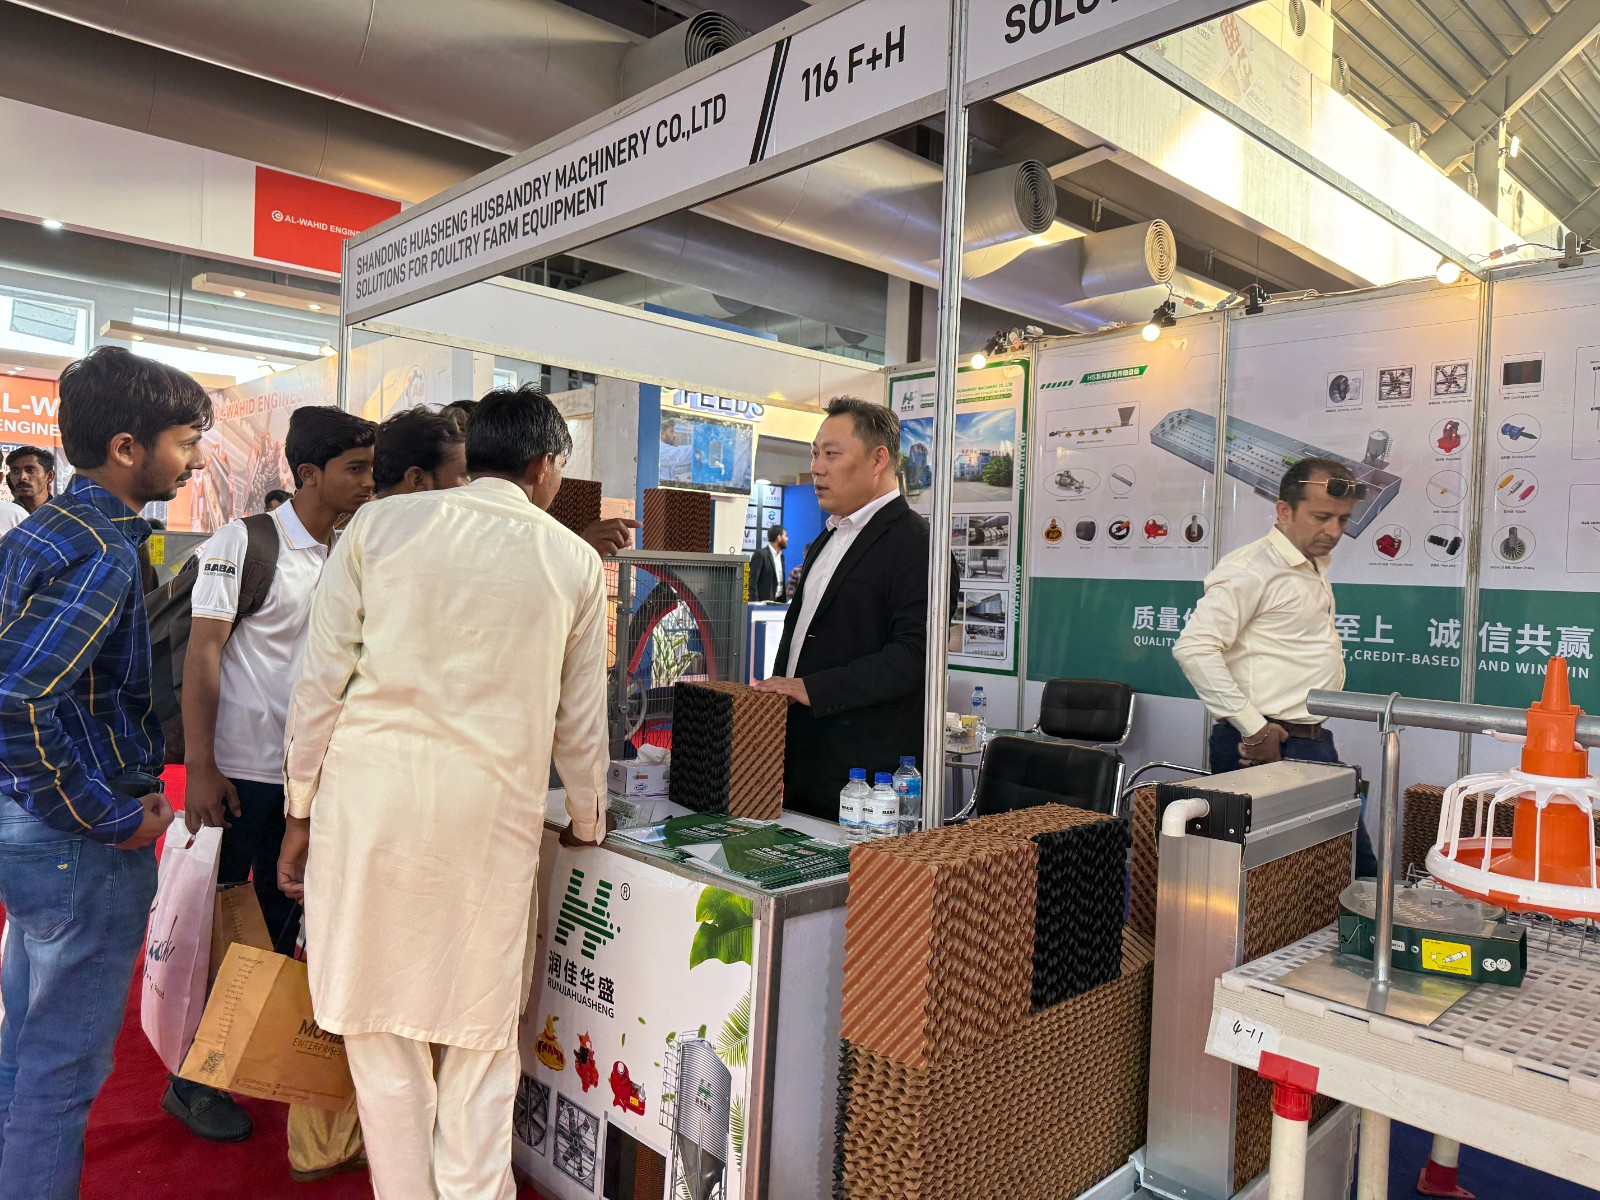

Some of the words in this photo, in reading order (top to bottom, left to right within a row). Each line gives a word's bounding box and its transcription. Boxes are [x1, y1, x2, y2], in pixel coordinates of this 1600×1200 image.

[801, 56, 838, 102] 116
[848, 25, 906, 83] F+H
[357, 237, 407, 276] SHANDONG
[409, 210, 468, 250] HUASHENG
[471, 171, 551, 229] HUSBANDRY
[555, 126, 651, 192] MACHINERY
[656, 93, 727, 148] CO.,LTD
[285, 214, 328, 231] AL-WAHID
[356, 263, 406, 299] SOLUTIONS
[408, 255, 428, 281] FOR
[431, 232, 481, 271] POULTRY
[483, 217, 519, 252] FARM
[523, 180, 608, 237] EQUIPMENT
[0, 392, 59, 417] L-W
[214, 398, 255, 422] AL-WAHID
[204, 563, 236, 576] BABA
[1132, 605, 1197, 632] 质量
[1478, 660, 1510, 672] AND
[1565, 666, 1589, 679] IN
[547, 951, 615, 1005] 润佳华盛
[547, 977, 615, 1018] RUNJIAHUASHENG
[292, 1037, 343, 1056] ENTERPRISES
